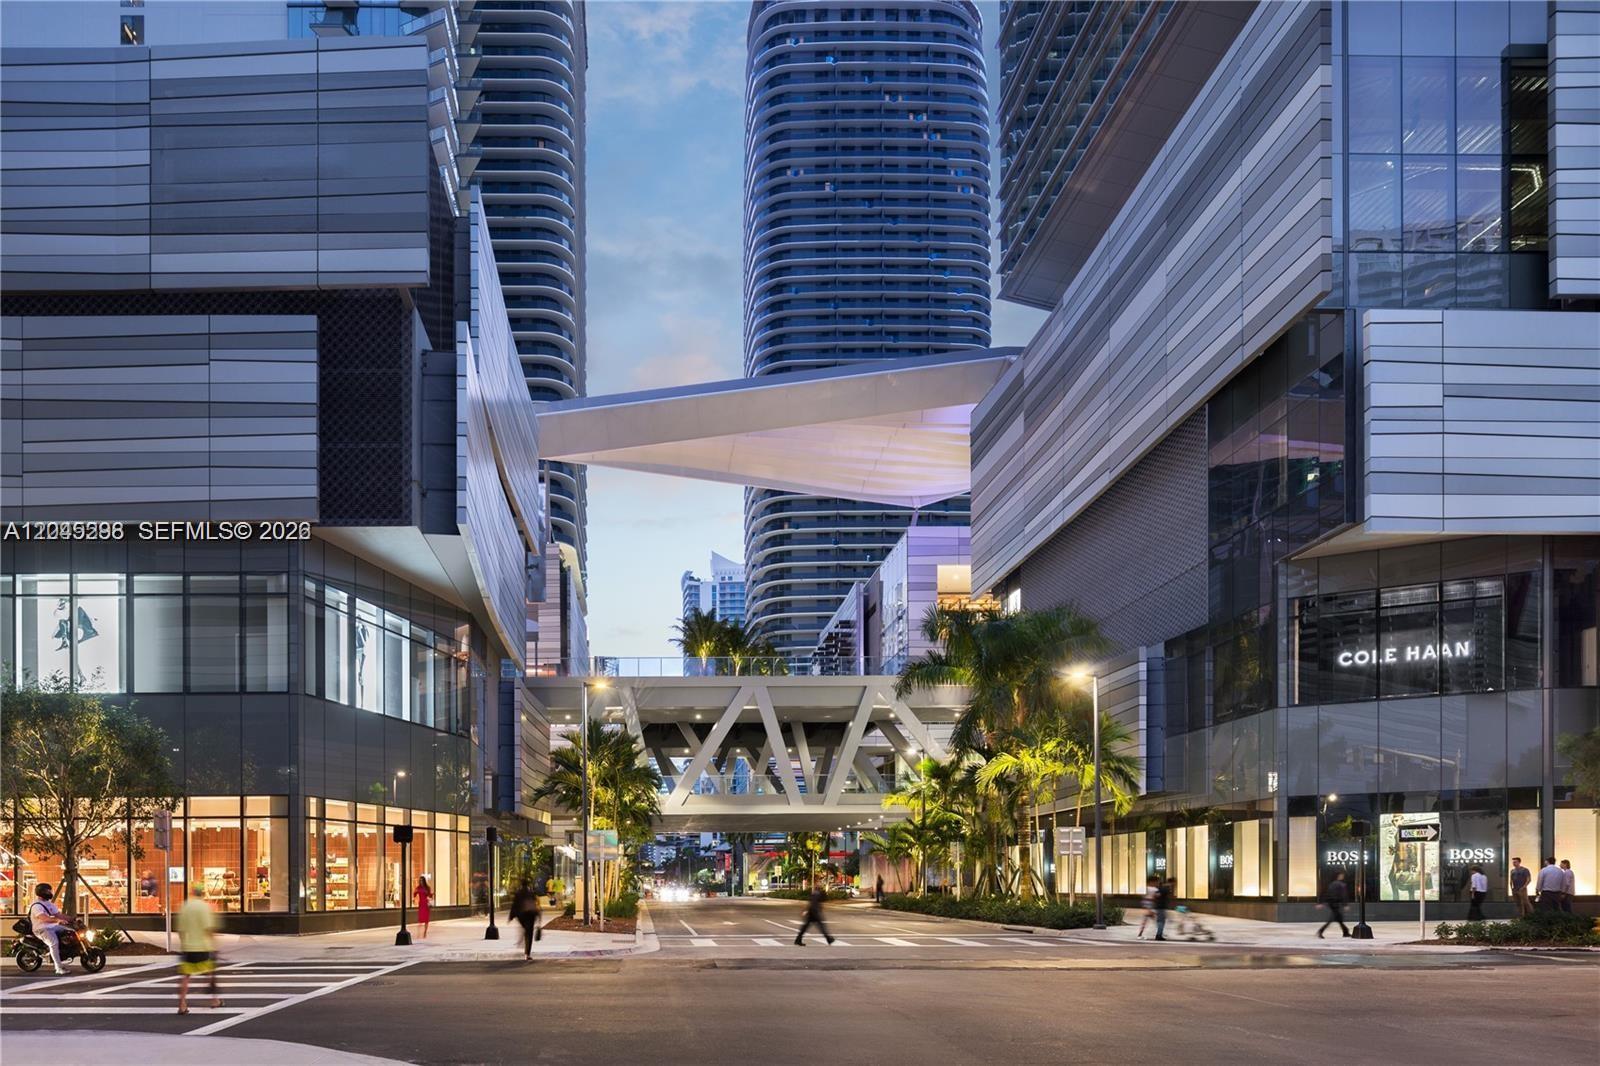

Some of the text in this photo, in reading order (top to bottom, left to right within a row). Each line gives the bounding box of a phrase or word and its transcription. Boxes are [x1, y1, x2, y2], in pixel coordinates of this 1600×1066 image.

[1338, 640, 1470, 667] COLE HAAN
[1449, 848, 1495, 860] BOSS
